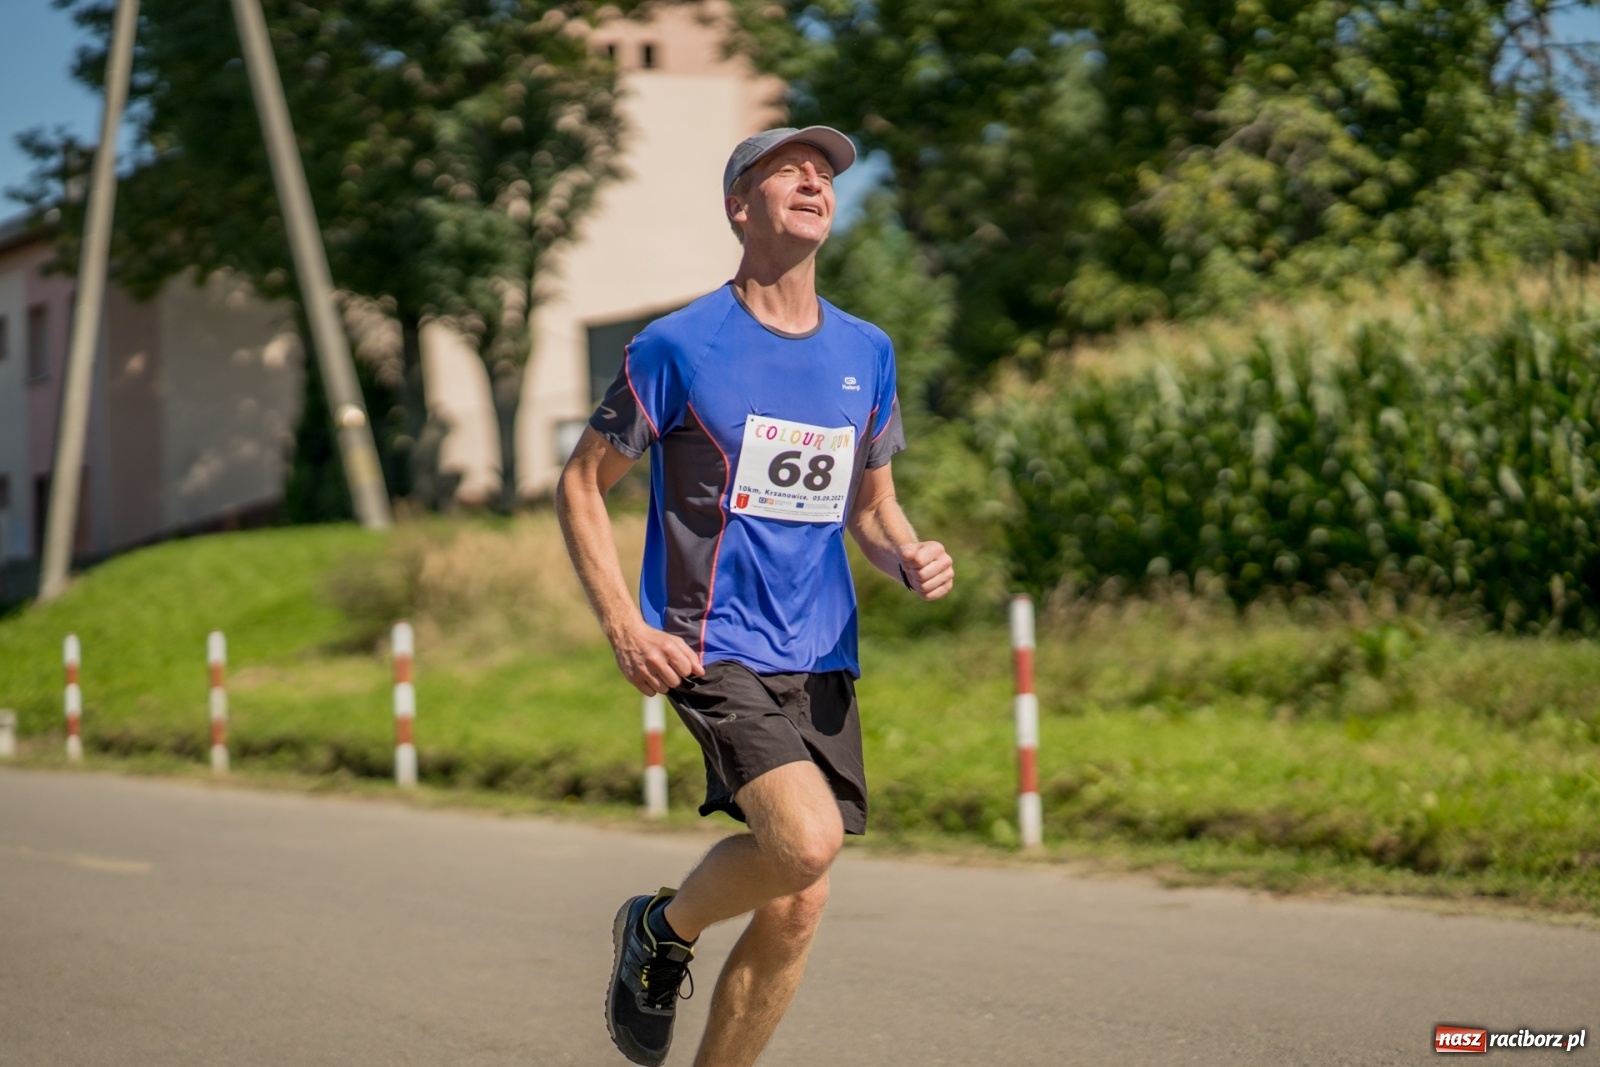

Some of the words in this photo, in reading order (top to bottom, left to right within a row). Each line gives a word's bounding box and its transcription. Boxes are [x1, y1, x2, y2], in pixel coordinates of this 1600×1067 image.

[755, 424, 825, 450] COLOUR
[830, 433, 850, 451] RUN
[768, 450, 835, 491] 68
[738, 485, 761, 495] 10km,
